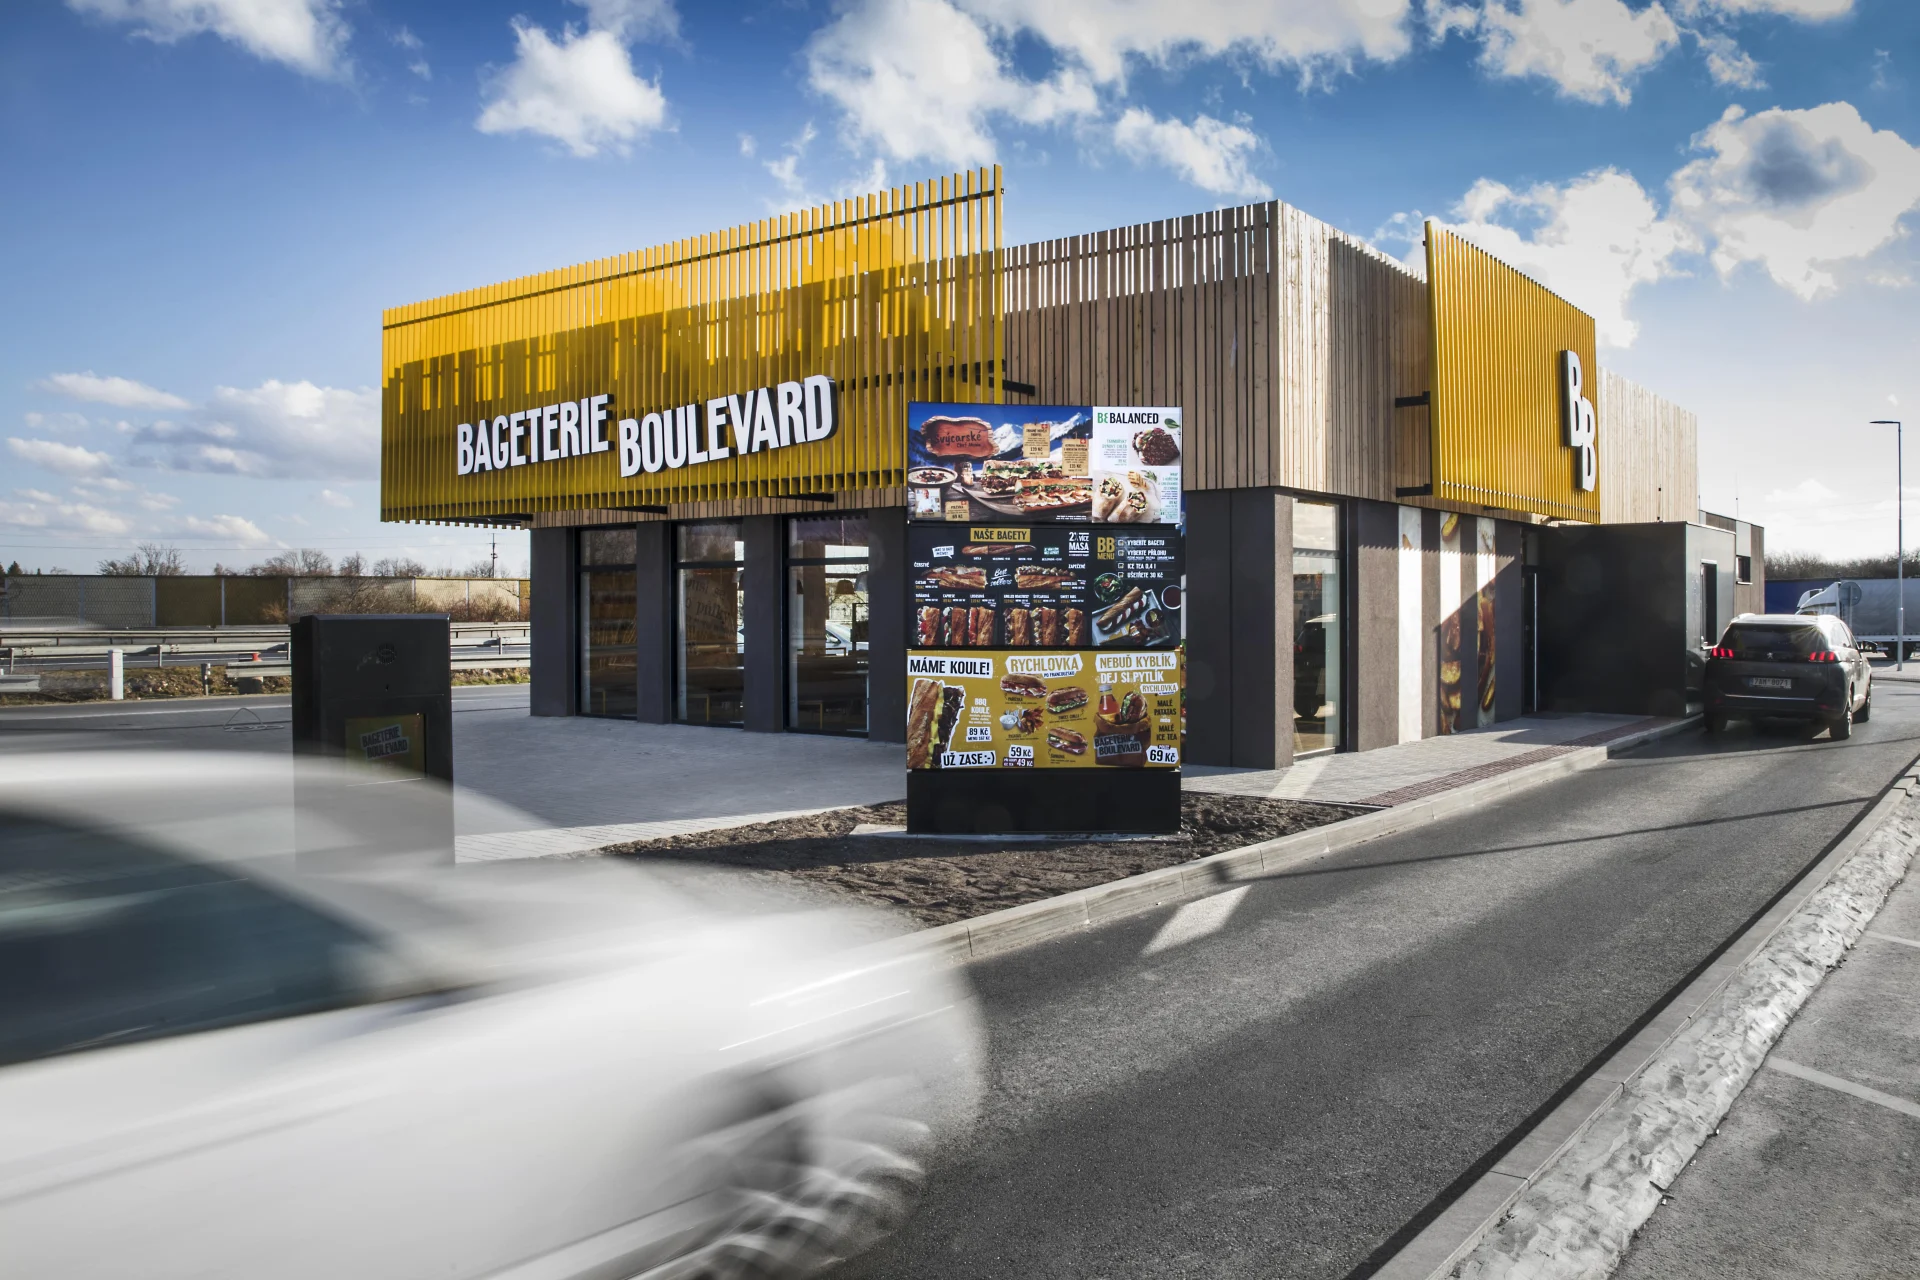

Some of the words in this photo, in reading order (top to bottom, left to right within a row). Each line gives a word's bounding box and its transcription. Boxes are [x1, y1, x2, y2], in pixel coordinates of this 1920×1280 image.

[457, 393, 614, 476] BAGETERIE
[618, 374, 837, 478] BOULEVARD
[973, 529, 995, 540] NAŠE
[997, 530, 1027, 541] BAGETY
[1068, 542, 1090, 551] MASA
[1097, 537, 1115, 553] BB
[909, 657, 946, 674] MÁME
[950, 660, 990, 676] KOULE!
[1010, 657, 1080, 672] RYCHLOVKA
[1100, 654, 1133, 669] NEBUĎ
[1100, 672, 1118, 684] DEJ
[1120, 671, 1130, 683] SI
[1132, 669, 1164, 683] PYTLÍK
[1142, 684, 1177, 692] RYCHLOVKA
[974, 698, 987, 706] BBQ
[1157, 698, 1173, 707] MALÉ
[1154, 708, 1177, 716] PATATAS
[969, 727, 978, 736] 89
[979, 727, 989, 736] Kč
[1158, 723, 1175, 732] MALÉ
[362, 726, 401, 748] BAGETERIE
[1156, 733, 1166, 741] ICE
[1167, 733, 1177, 741] TEA
[367, 739, 408, 759] BOULEVARD
[1010, 746, 1022, 757] 59
[1022, 748, 1032, 757] Kč
[1099, 743, 1140, 756] BOULEVARD
[943, 752, 956, 766] UŽ
[1149, 749, 1163, 762] 69
[1165, 752, 1176, 763] Kč
[1016, 758, 1026, 767] 49
